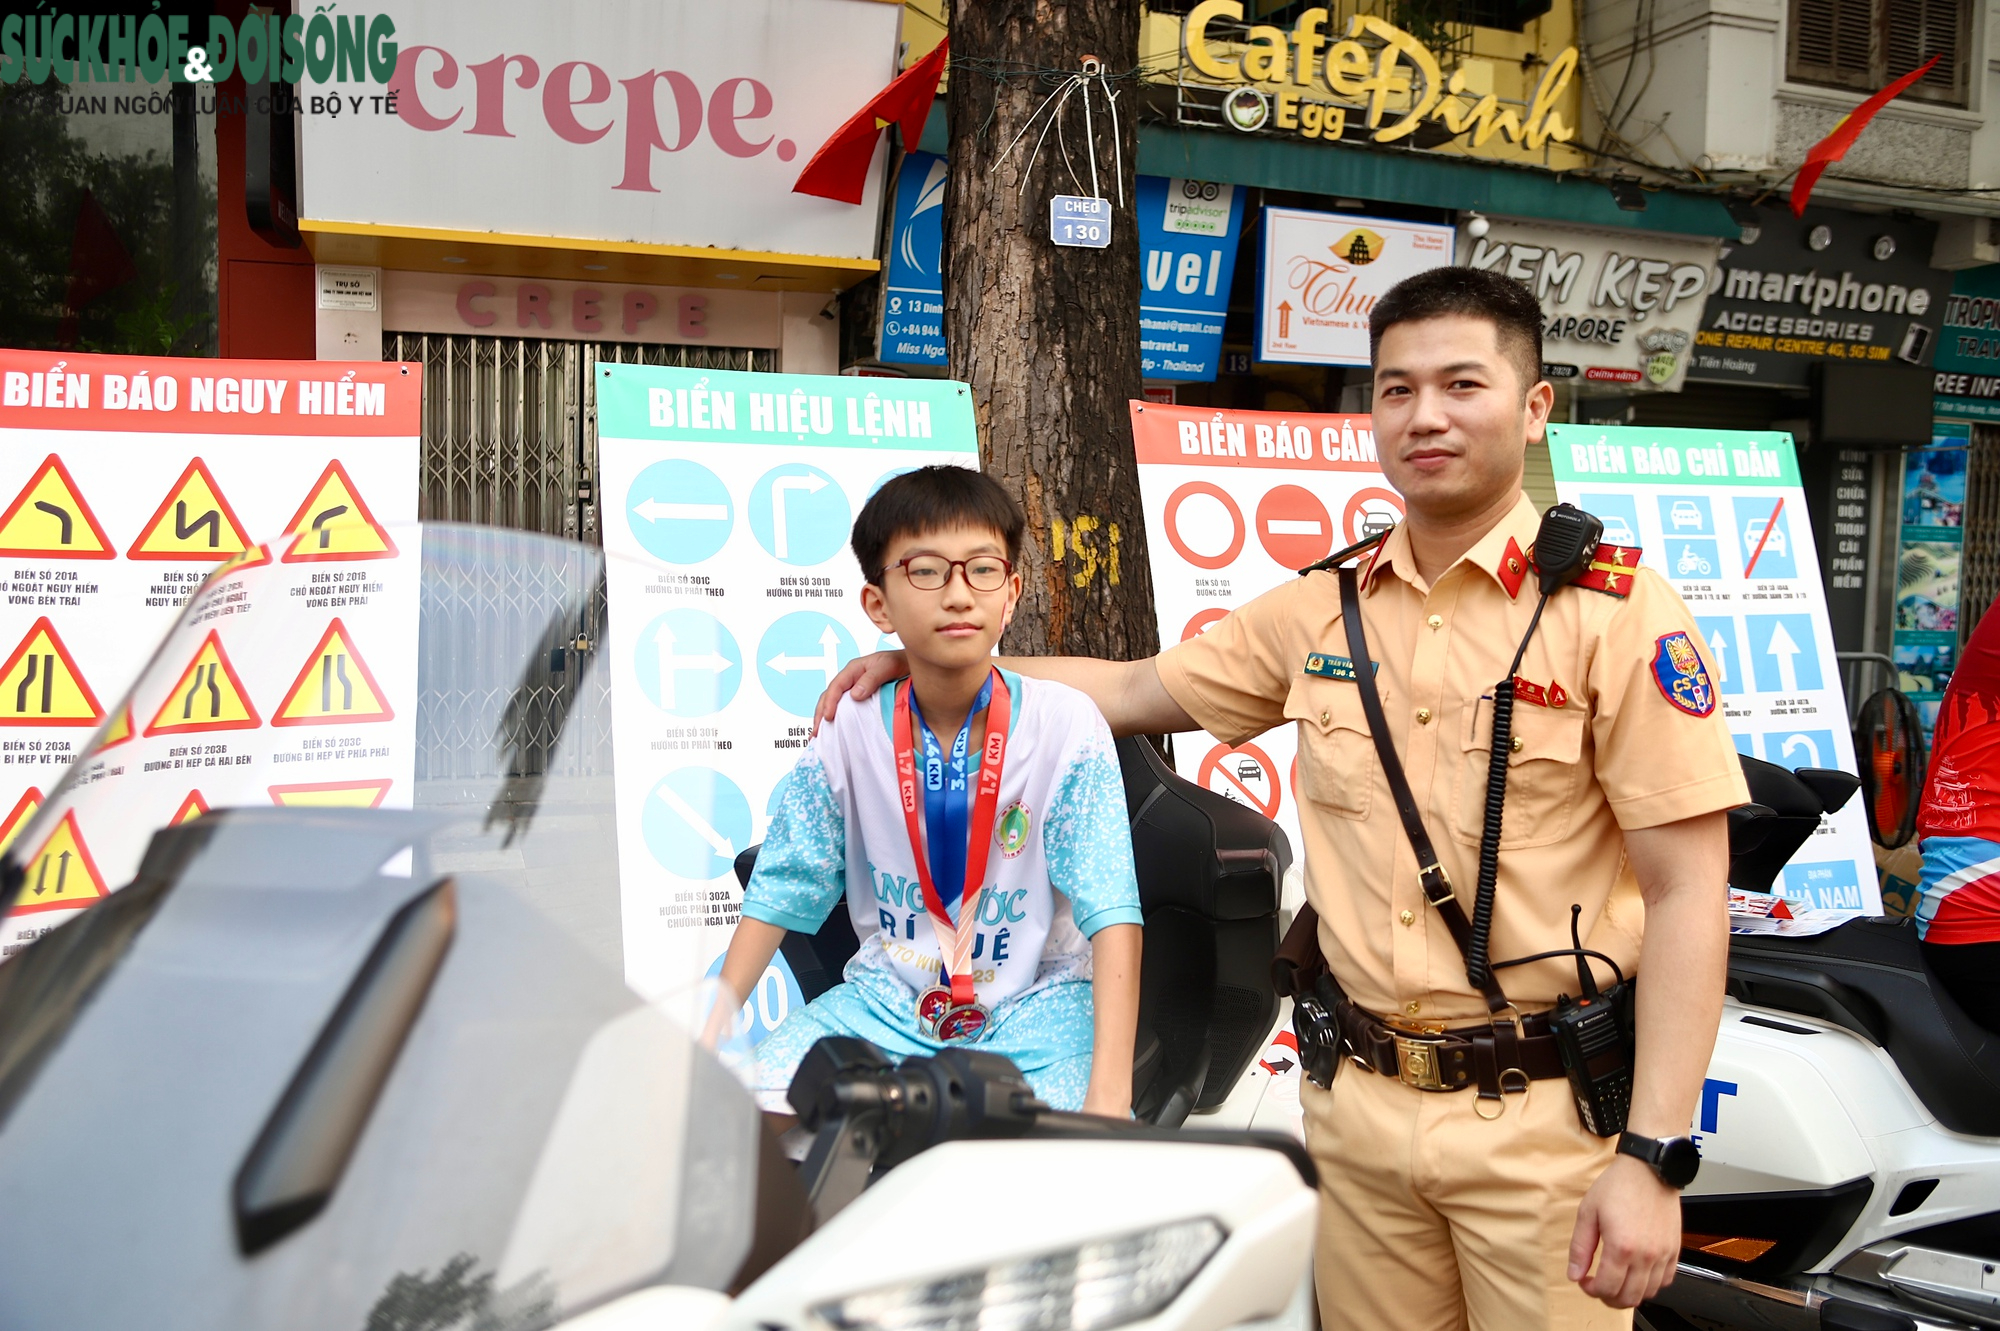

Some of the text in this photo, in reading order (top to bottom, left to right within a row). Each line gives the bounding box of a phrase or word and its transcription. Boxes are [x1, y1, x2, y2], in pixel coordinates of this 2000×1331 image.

[387, 45, 797, 193] crepe.
[1274, 92, 1346, 141] Egg
[1169, 203, 1225, 218] tripadvisor
[1064, 225, 1100, 241] 130
[1146, 250, 1222, 297] vel
[1470, 238, 1706, 322] KEM KẸP
[456, 280, 708, 338] CREPE
[908, 300, 922, 313] 13
[902, 324, 940, 337] +84 944
[1138, 318, 1222, 334] elhanoi@gmail.com
[1302, 316, 1349, 329] Vietnamese
[1713, 311, 1874, 341] ACCESSORIES
[896, 342, 946, 358] Miss Nga
[1140, 340, 1189, 353] mtravel.vn
[1695, 331, 1723, 346] ONE
[1726, 333, 1774, 349] REPAIR
[1774, 338, 1824, 355] CENTRE
[1867, 346, 1891, 360] SIM
[1229, 355, 1248, 372] 13
[4, 360, 386, 416] BIỂN BÁO NGUY HIỂM
[1934, 373, 1969, 394] REE
[648, 376, 932, 444] BIỂN HIỆU LỆNH
[1178, 412, 1380, 463] BIỂN BÁO CẤM
[1570, 435, 1781, 479] BIỂN BÁO CHỈ DẪN
[55, 571, 78, 581] 201A
[346, 571, 367, 581] 201B
[690, 576, 710, 585] 301C
[811, 577, 831, 586] 301D
[338, 584, 360, 594] NGUY
[704, 588, 724, 597] THEO
[824, 588, 844, 598] THEO
[1673, 677, 1692, 693] CS
[45, 741, 71, 751] 203A
[204, 744, 228, 755] 203B
[338, 737, 362, 748] 203C
[713, 740, 733, 750] THEO
[218, 756, 233, 766] HAI
[950, 731, 966, 791] 3.4 KM
[980, 737, 1001, 796] 1.7 KM
[897, 749, 913, 808] 1.7 KM
[929, 763, 939, 785] KM
[709, 891, 730, 901] 302A
[1818, 885, 1861, 909] NAM
[878, 907, 916, 941] RÍ
[972, 968, 995, 983] 23
